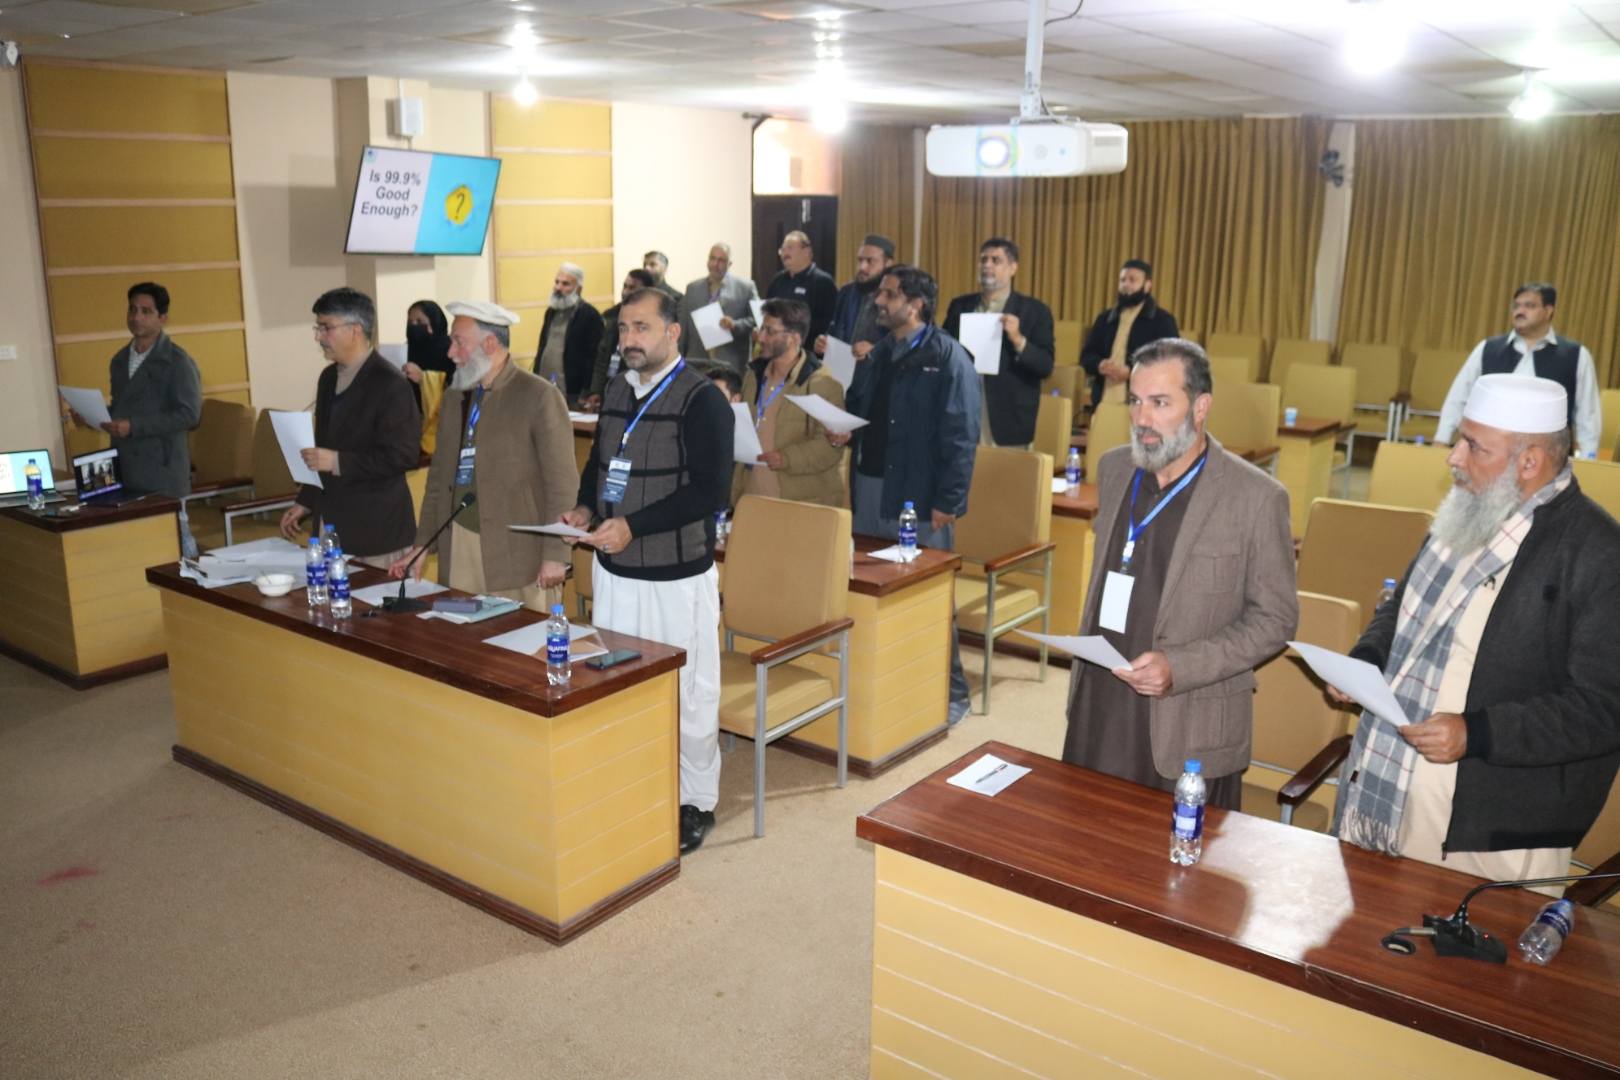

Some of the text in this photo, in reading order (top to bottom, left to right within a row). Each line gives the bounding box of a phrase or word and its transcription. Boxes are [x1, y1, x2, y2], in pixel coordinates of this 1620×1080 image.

[369, 170, 421, 185] Is 99.9%
[376, 186, 410, 200] Good
[361, 202, 418, 219] Enough?
